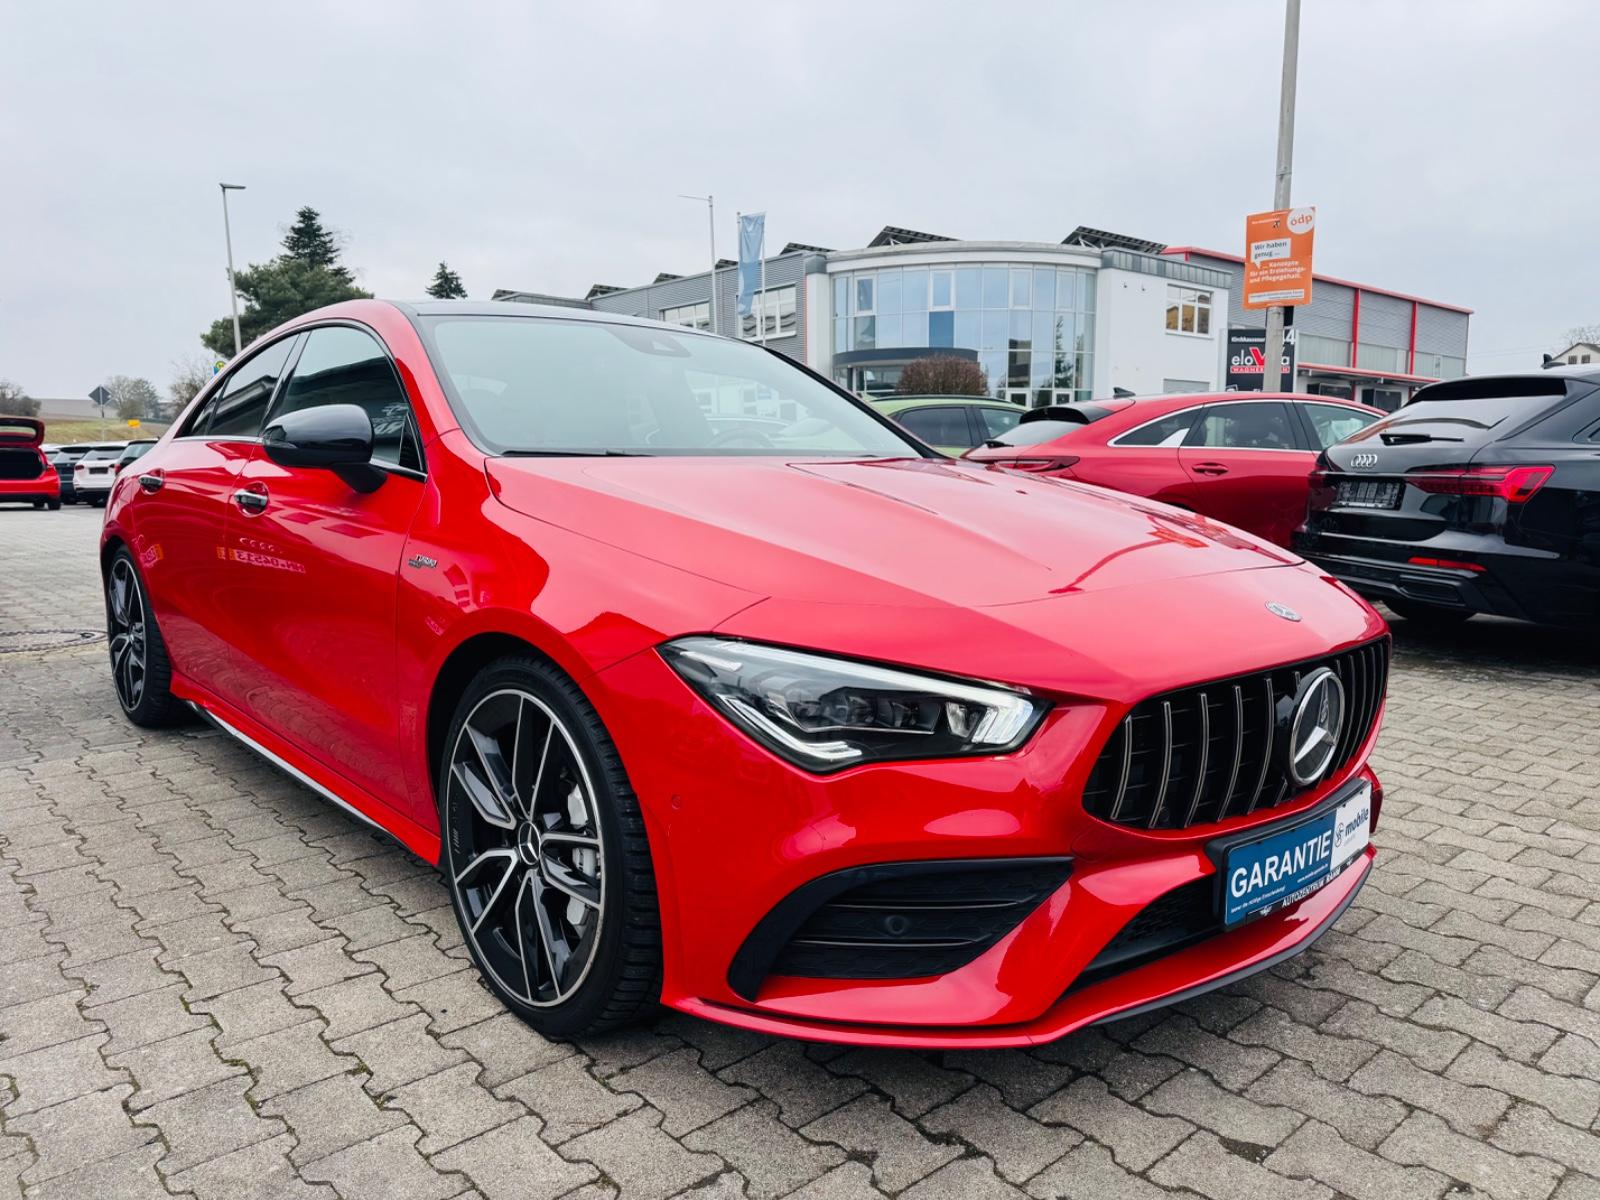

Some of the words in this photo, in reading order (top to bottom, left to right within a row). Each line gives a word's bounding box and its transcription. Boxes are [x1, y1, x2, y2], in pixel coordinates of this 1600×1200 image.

[1266, 241, 1287, 249] haben
[1254, 251, 1273, 260] genug
[1345, 808, 1369, 837] mobile
[1231, 830, 1332, 898] GARANTIE
